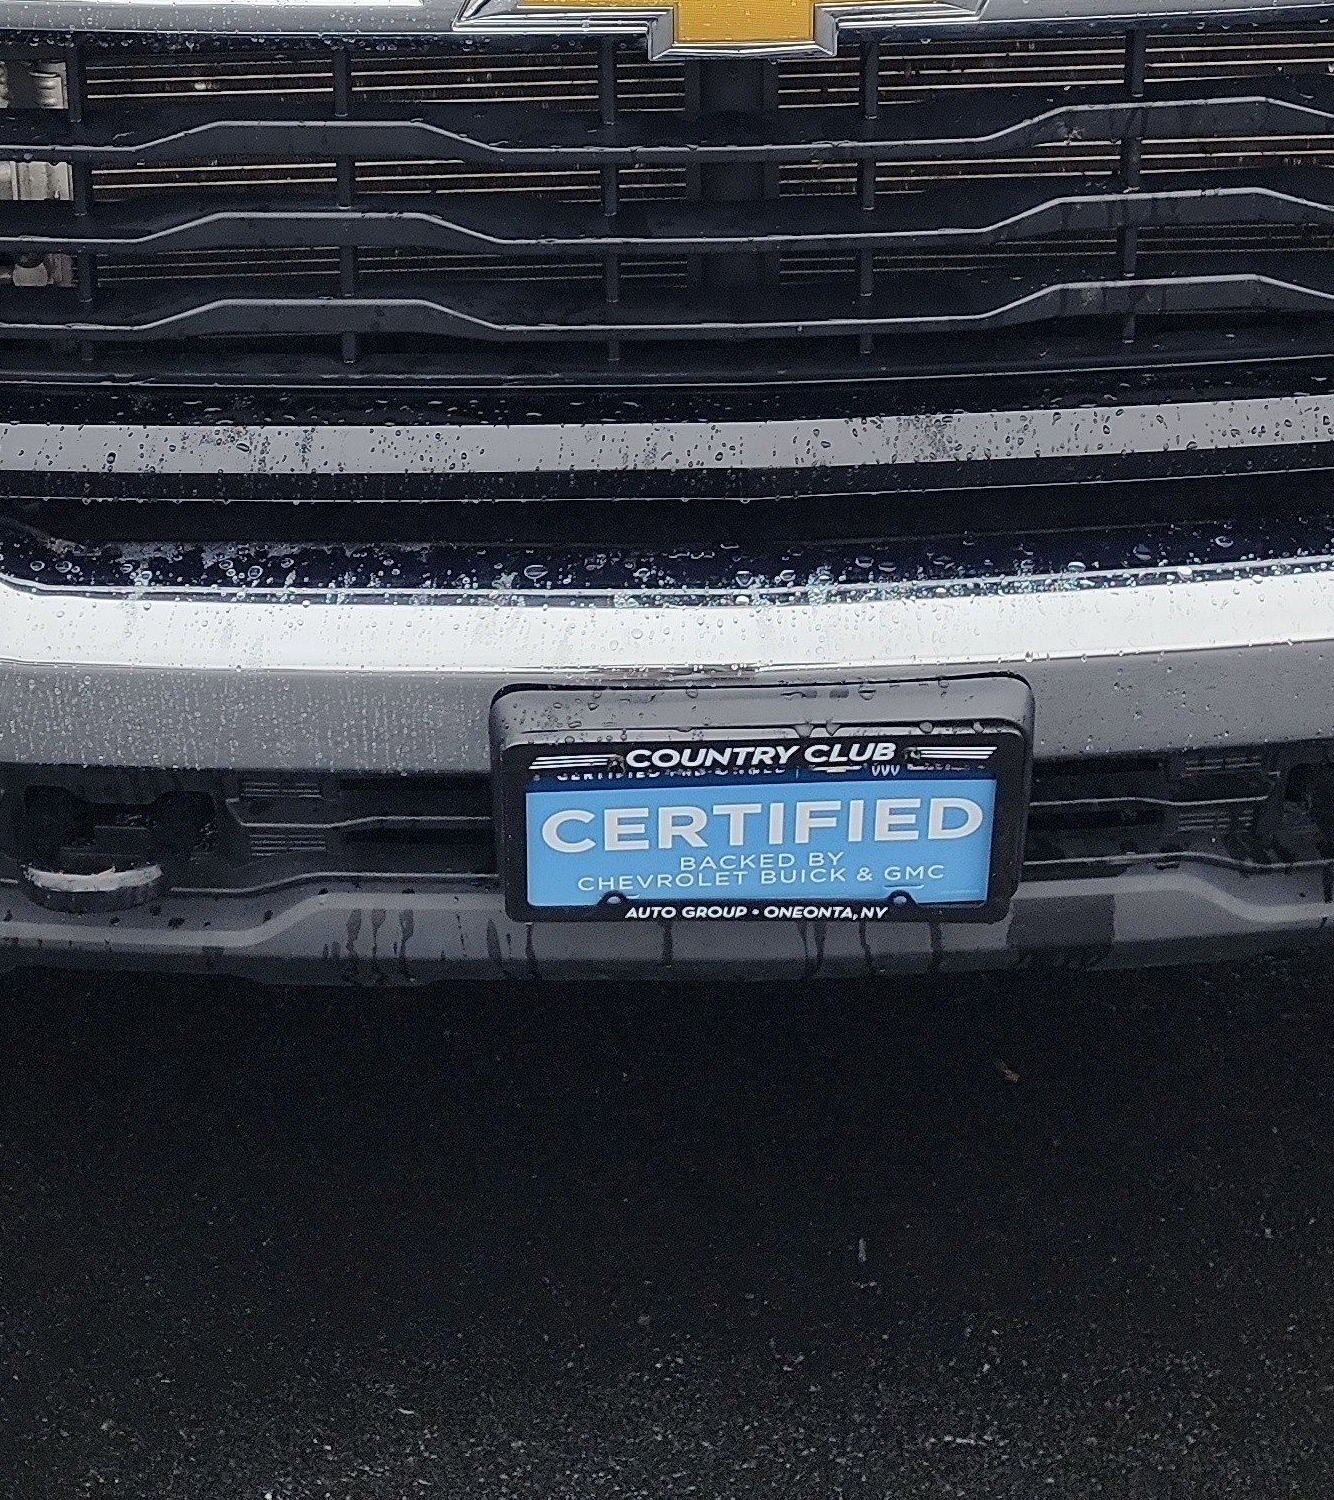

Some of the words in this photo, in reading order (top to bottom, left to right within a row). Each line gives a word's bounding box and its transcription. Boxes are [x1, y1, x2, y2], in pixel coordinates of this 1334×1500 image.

[625, 746, 798, 768] COUNTRY
[804, 742, 897, 763] CLUB
[541, 797, 984, 854] CERTIFIED
[680, 853, 795, 871] BACKED
[808, 851, 844, 866] BY
[577, 871, 748, 892] CHEVROLET
[760, 867, 846, 885] BUICK
[856, 866, 873, 882] &
[883, 864, 945, 881] GMC
[624, 906, 677, 919] AUTO
[681, 906, 748, 919] GROUP
